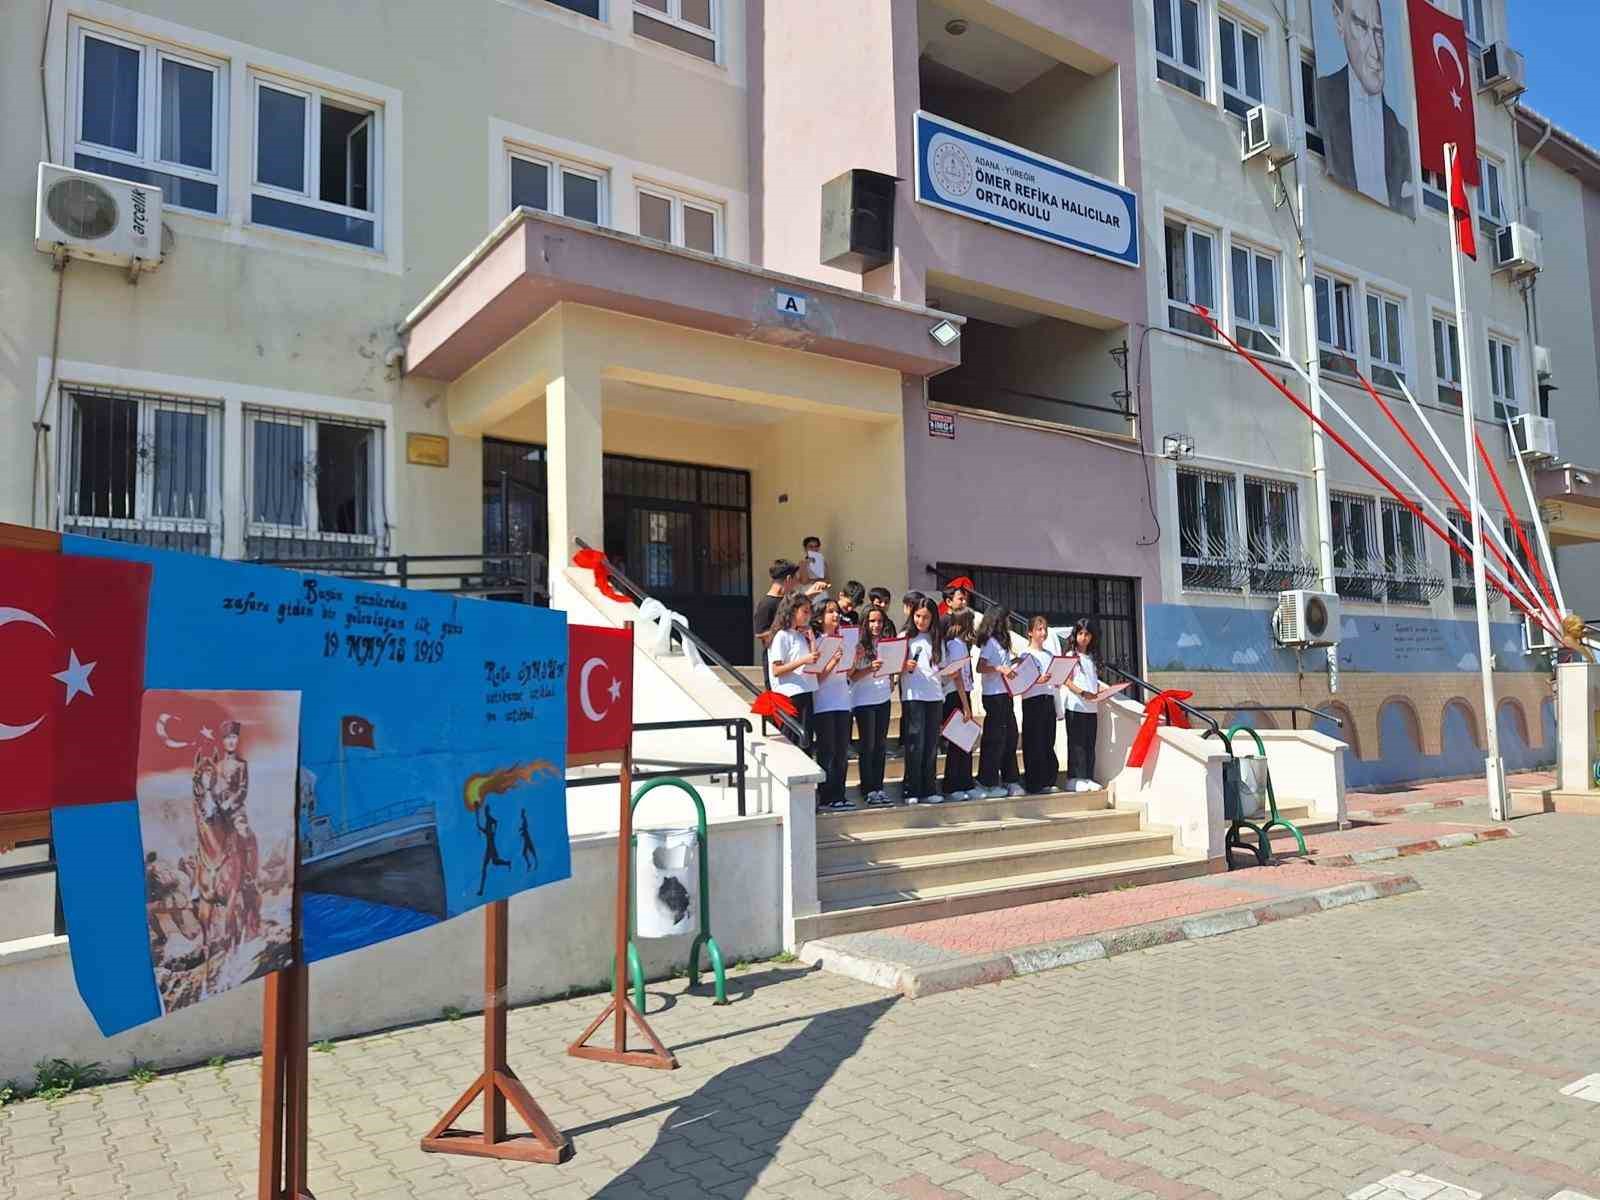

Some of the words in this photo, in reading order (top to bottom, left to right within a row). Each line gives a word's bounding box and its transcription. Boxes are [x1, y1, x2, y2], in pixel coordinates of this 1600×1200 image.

[975, 156, 1000, 170] ADANA
[131, 188, 149, 236] arçelik
[975, 168, 1012, 192] ÖMER
[1015, 186, 1059, 208] REFİKA
[1061, 198, 1120, 229] HALICILAR
[976, 187, 1051, 222] ORTAOKULU
[785, 296, 799, 312] A
[323, 631, 340, 657] 19
[414, 639, 445, 664] 1919
